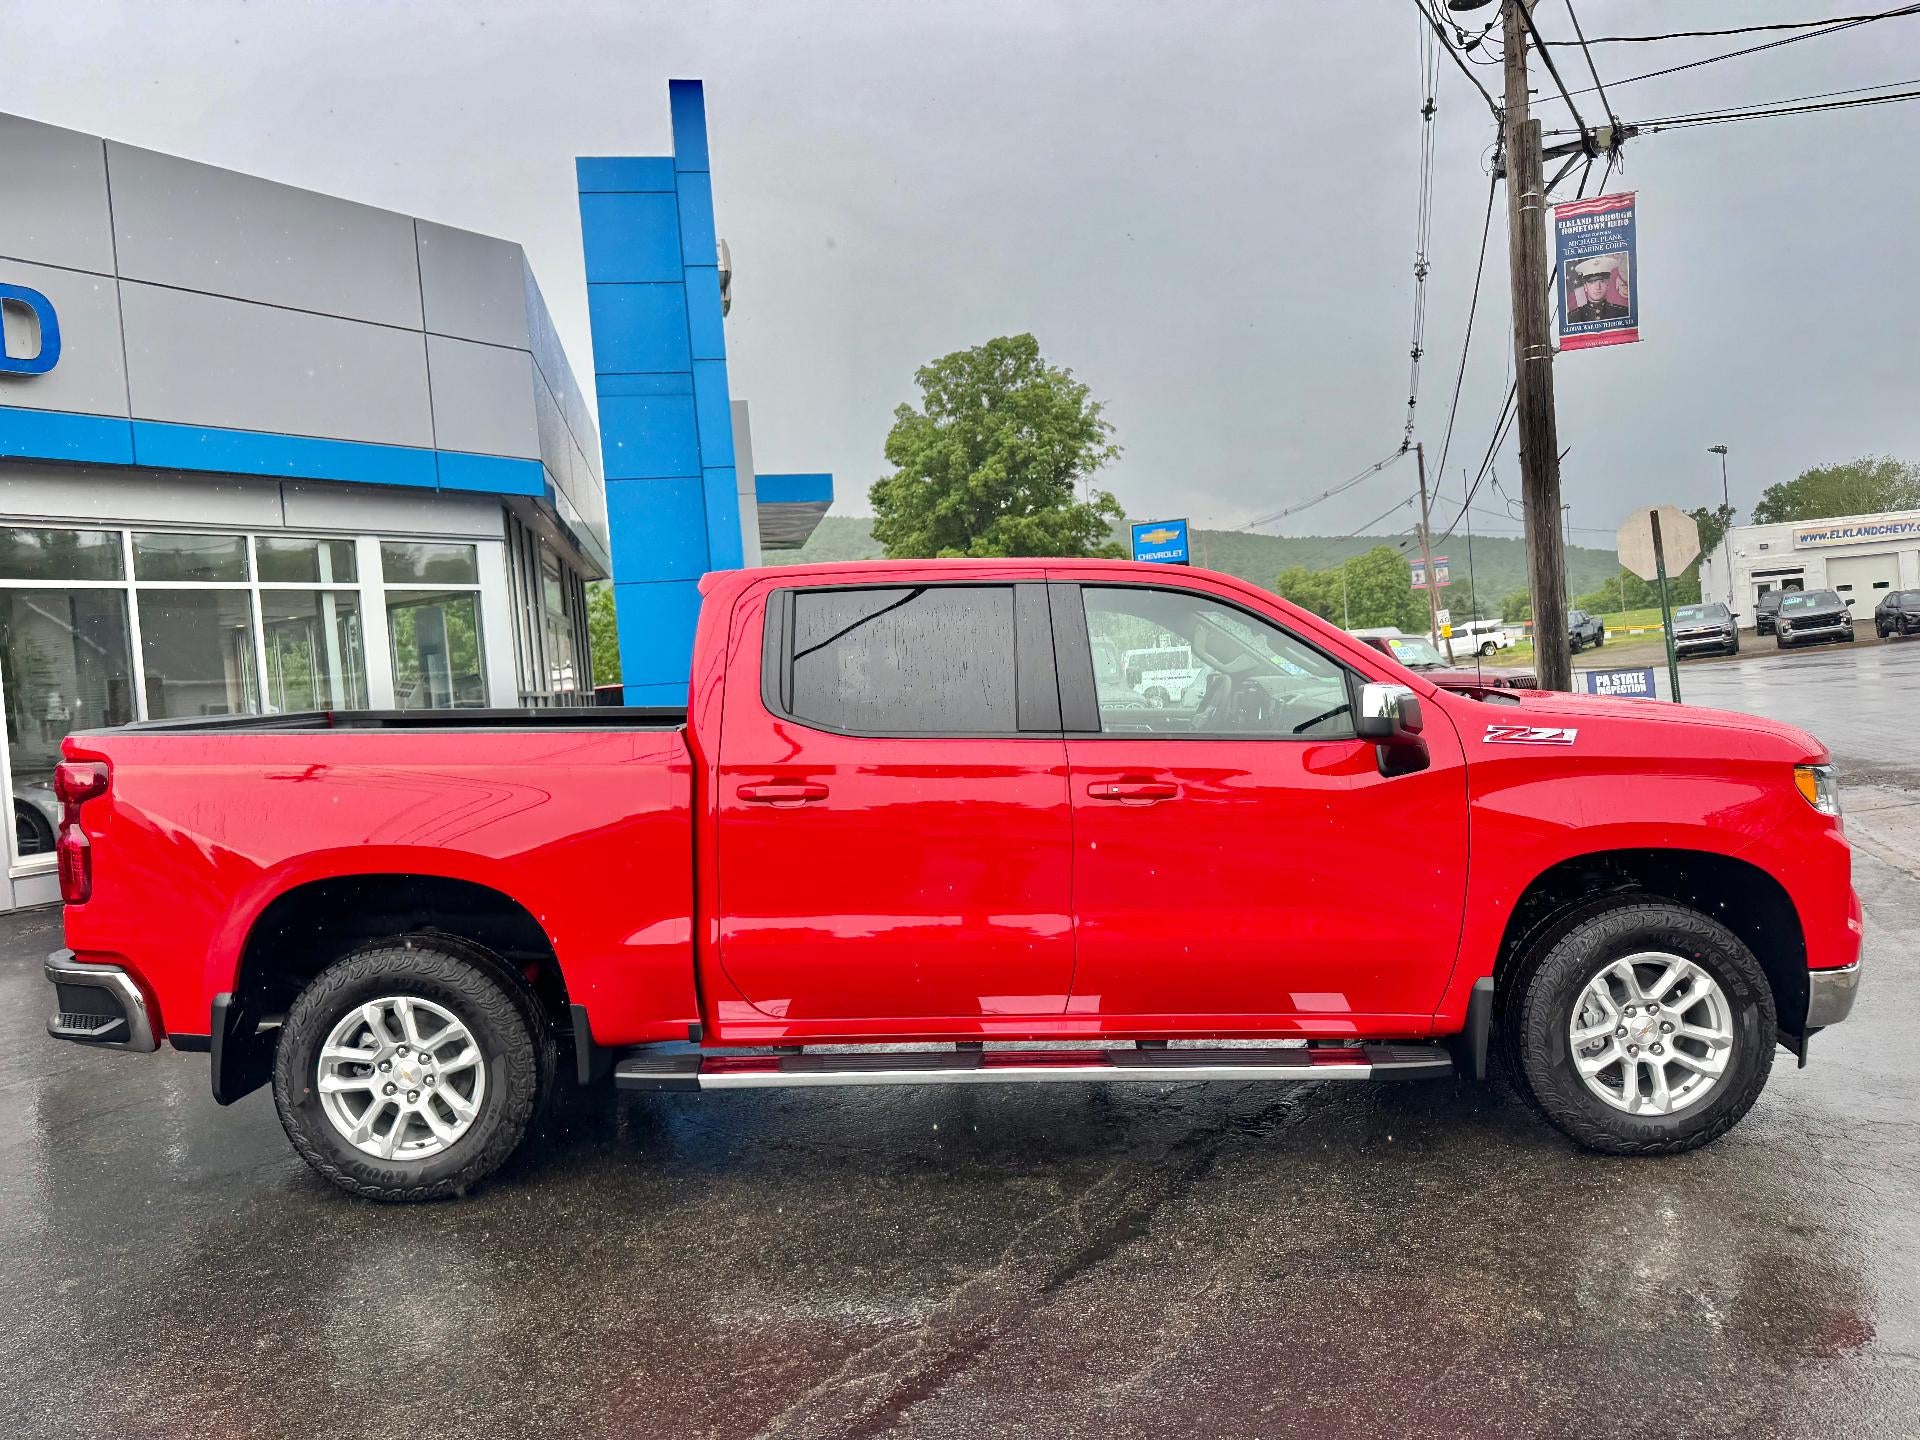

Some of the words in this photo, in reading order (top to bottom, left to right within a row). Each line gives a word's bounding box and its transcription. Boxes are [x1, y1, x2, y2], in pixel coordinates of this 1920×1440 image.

[1559, 216, 1592, 229] ELKLAND
[1594, 211, 1633, 223] BOROUGH
[1561, 222, 1605, 235] HOMETOWN
[1607, 218, 1630, 228] HERO
[1578, 244, 1604, 254] MARINE
[1605, 241, 1628, 250] CORPS
[1137, 549, 1183, 561] CHEVROLET
[1596, 674, 1611, 687] PA
[1612, 672, 1646, 686] STATE
[1597, 683, 1647, 696] INSPECTION
[1482, 724, 1578, 745] Z71
